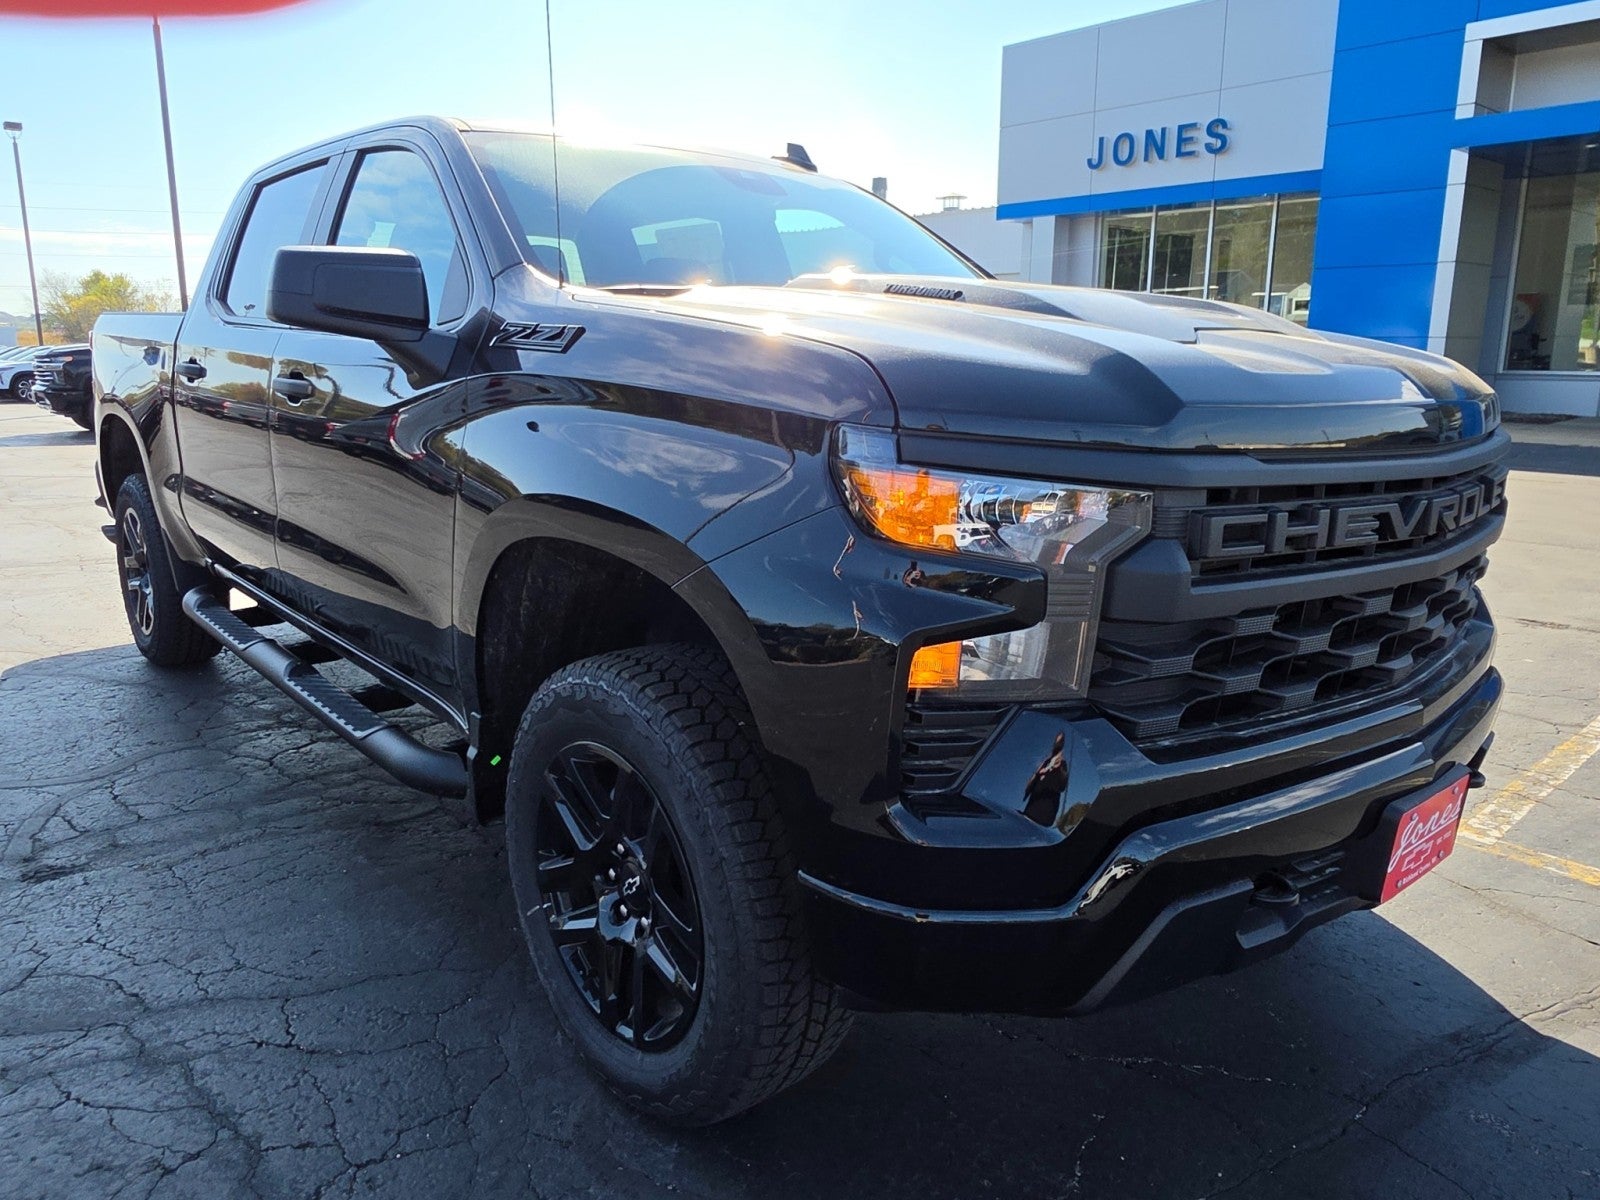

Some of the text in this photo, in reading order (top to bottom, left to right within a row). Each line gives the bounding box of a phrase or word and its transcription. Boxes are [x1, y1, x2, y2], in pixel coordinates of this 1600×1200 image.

[1086, 118, 1230, 170] JONES
[884, 283, 962, 301] TURBOMAX
[489, 320, 586, 354] Z71
[1203, 477, 1505, 557] CHEVROLE
[1387, 793, 1464, 873] Jones
